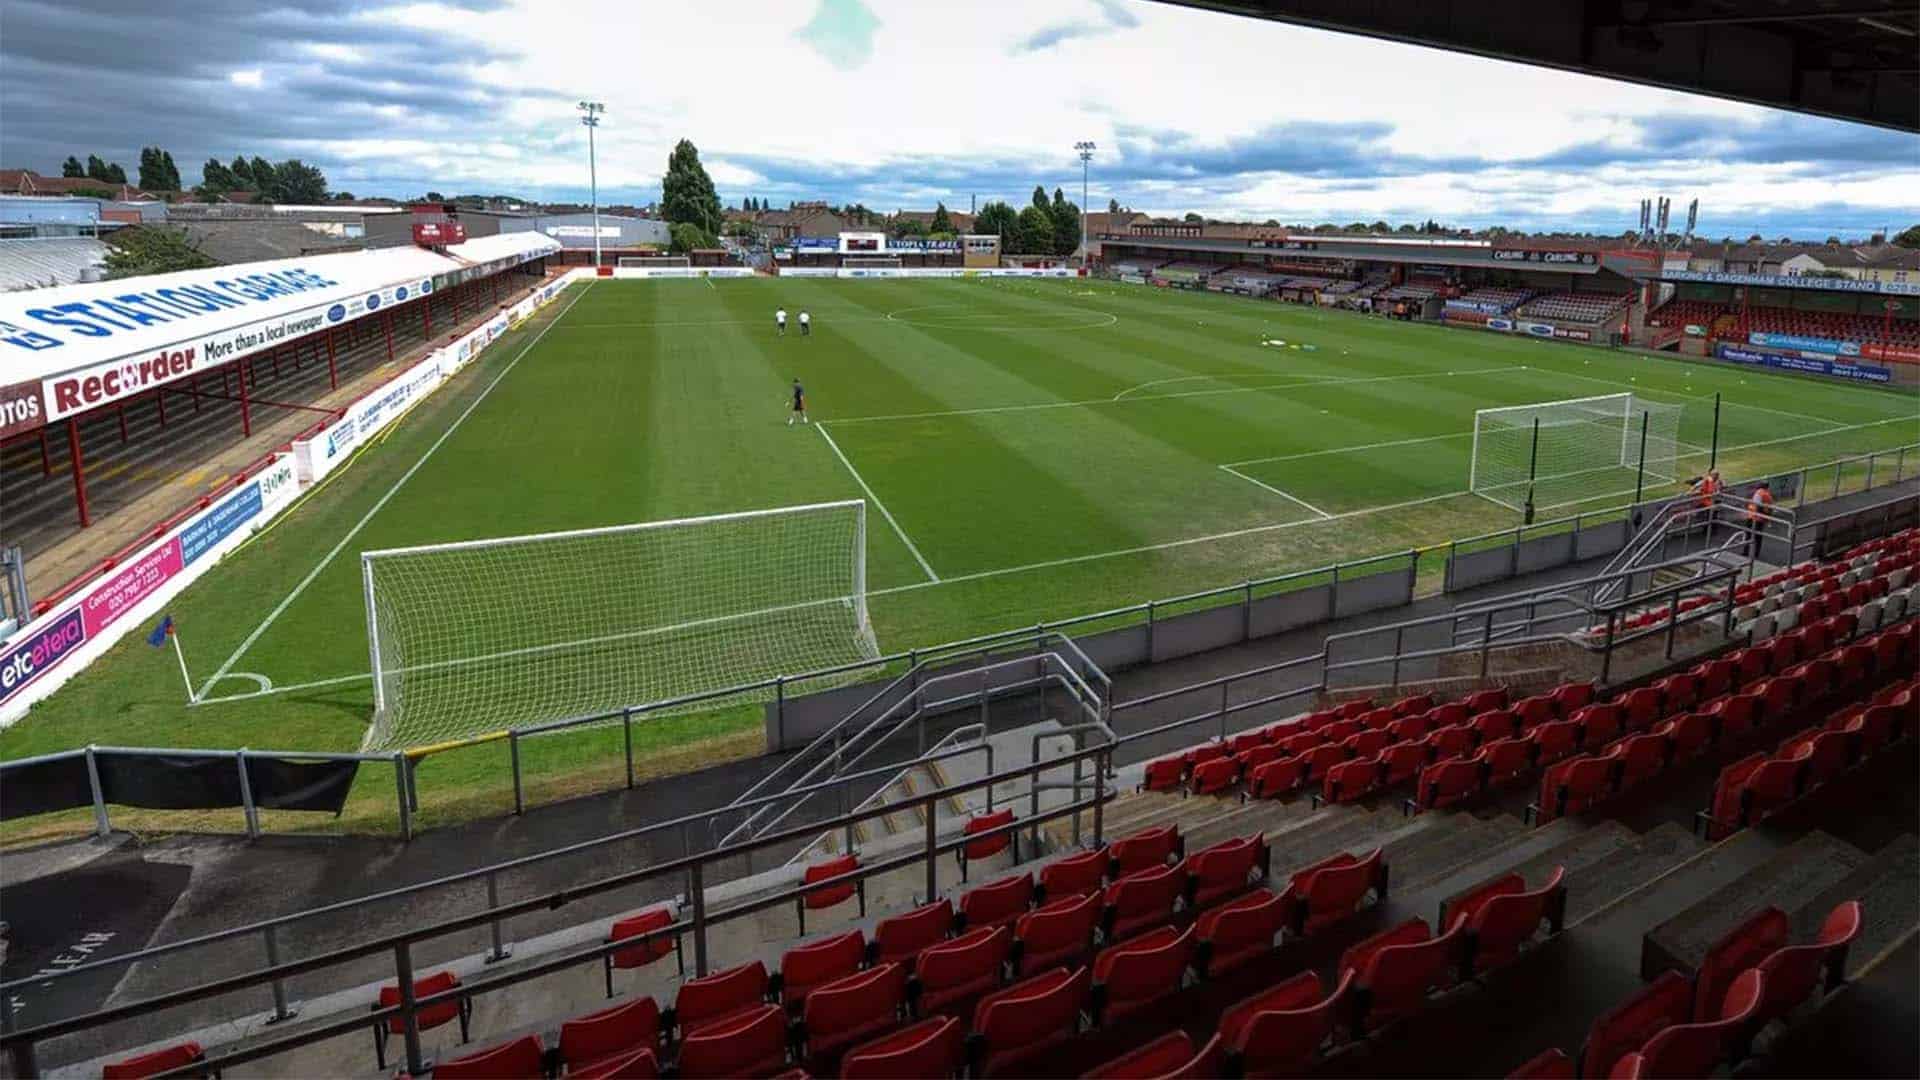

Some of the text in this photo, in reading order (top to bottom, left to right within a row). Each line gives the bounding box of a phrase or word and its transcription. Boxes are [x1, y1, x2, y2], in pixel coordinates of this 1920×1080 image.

[888, 240, 960, 249] UTOPIA TRAVEL
[25, 268, 339, 337] STATION GARAGE
[1662, 269, 1702, 280] BARKING
[1706, 271, 1714, 281] &
[1716, 272, 1775, 285] DAGENHAM
[1778, 276, 1830, 289] COLLEGE
[1835, 279, 1875, 291] STAND
[54, 314, 324, 413] Recorder More than a local newspaper
[88, 573, 134, 610] Construction
[134, 554, 162, 577] Services
[160, 544, 173, 559] Ltd
[1, 618, 80, 688] etcetera
